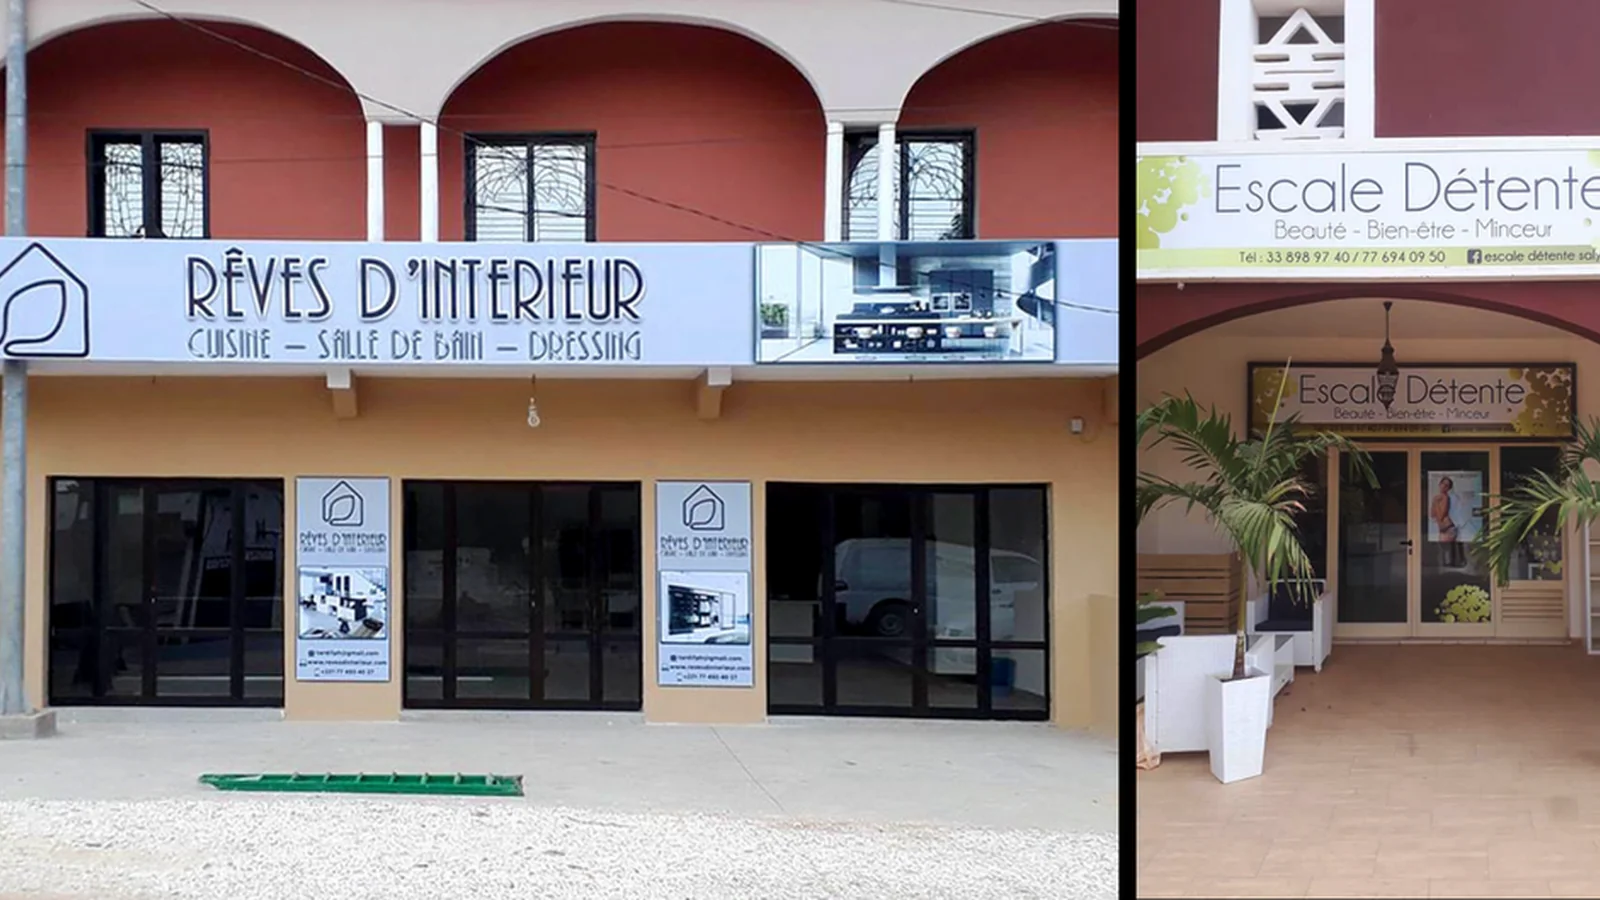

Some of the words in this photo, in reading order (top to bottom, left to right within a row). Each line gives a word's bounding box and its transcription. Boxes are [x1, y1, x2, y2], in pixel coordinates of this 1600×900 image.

[1215, 162, 1384, 214] Escale
[1404, 161, 1600, 213] Détente
[1274, 219, 1347, 240] Beauté
[1366, 218, 1456, 240] Bien-être
[1474, 217, 1553, 239] Minceur
[1266, 251, 1283, 263] 33
[1285, 251, 1311, 263] 898
[1313, 251, 1330, 263] 97
[1333, 251, 1350, 263] 40
[1362, 251, 1378, 263] 77
[1381, 251, 1405, 263] 694
[1408, 251, 1426, 263] 09
[1429, 250, 1446, 263] 50
[1484, 250, 1525, 262] escale
[1527, 248, 1575, 262] détente
[186, 247, 332, 319] RÊVES
[187, 328, 271, 359] CUISINE
[317, 328, 379, 360] SALLE
[390, 329, 423, 360] DE
[434, 329, 483, 361] BAIN
[528, 330, 642, 361] DRESSING
[1300, 373, 1396, 405] Escale
[1406, 375, 1526, 405] Détente
[1333, 405, 1376, 420] Beauté
[1386, 406, 1436, 420] Bien-être
[1446, 406, 1491, 420] Minceur
